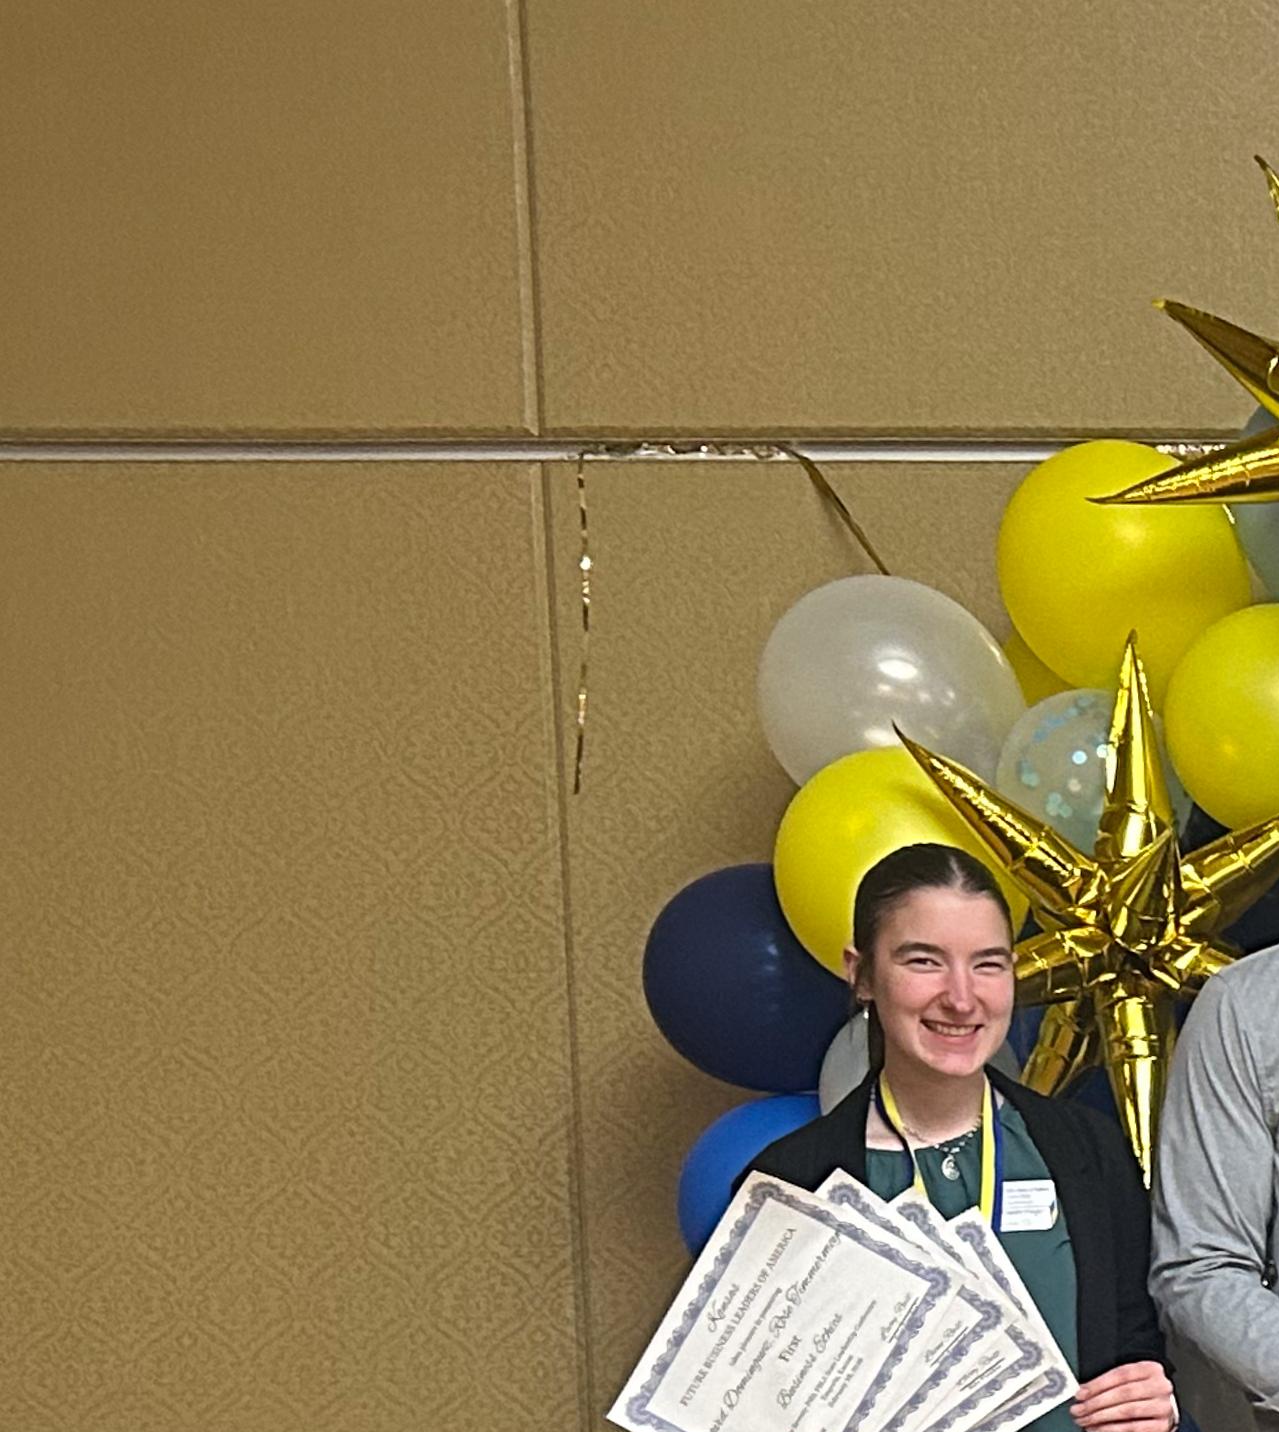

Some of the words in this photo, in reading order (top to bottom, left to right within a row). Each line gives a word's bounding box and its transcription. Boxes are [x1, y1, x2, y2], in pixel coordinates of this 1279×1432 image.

[679, 1368, 708, 1406] FUTURE
[703, 1325, 735, 1369] BUSINESS
[731, 1283, 761, 1325] LEADERS
[757, 1269, 769, 1283] OF
[766, 1228, 797, 1270] AMERICA
[707, 1283, 740, 1333] Kansas
[777, 1335, 802, 1362] First
